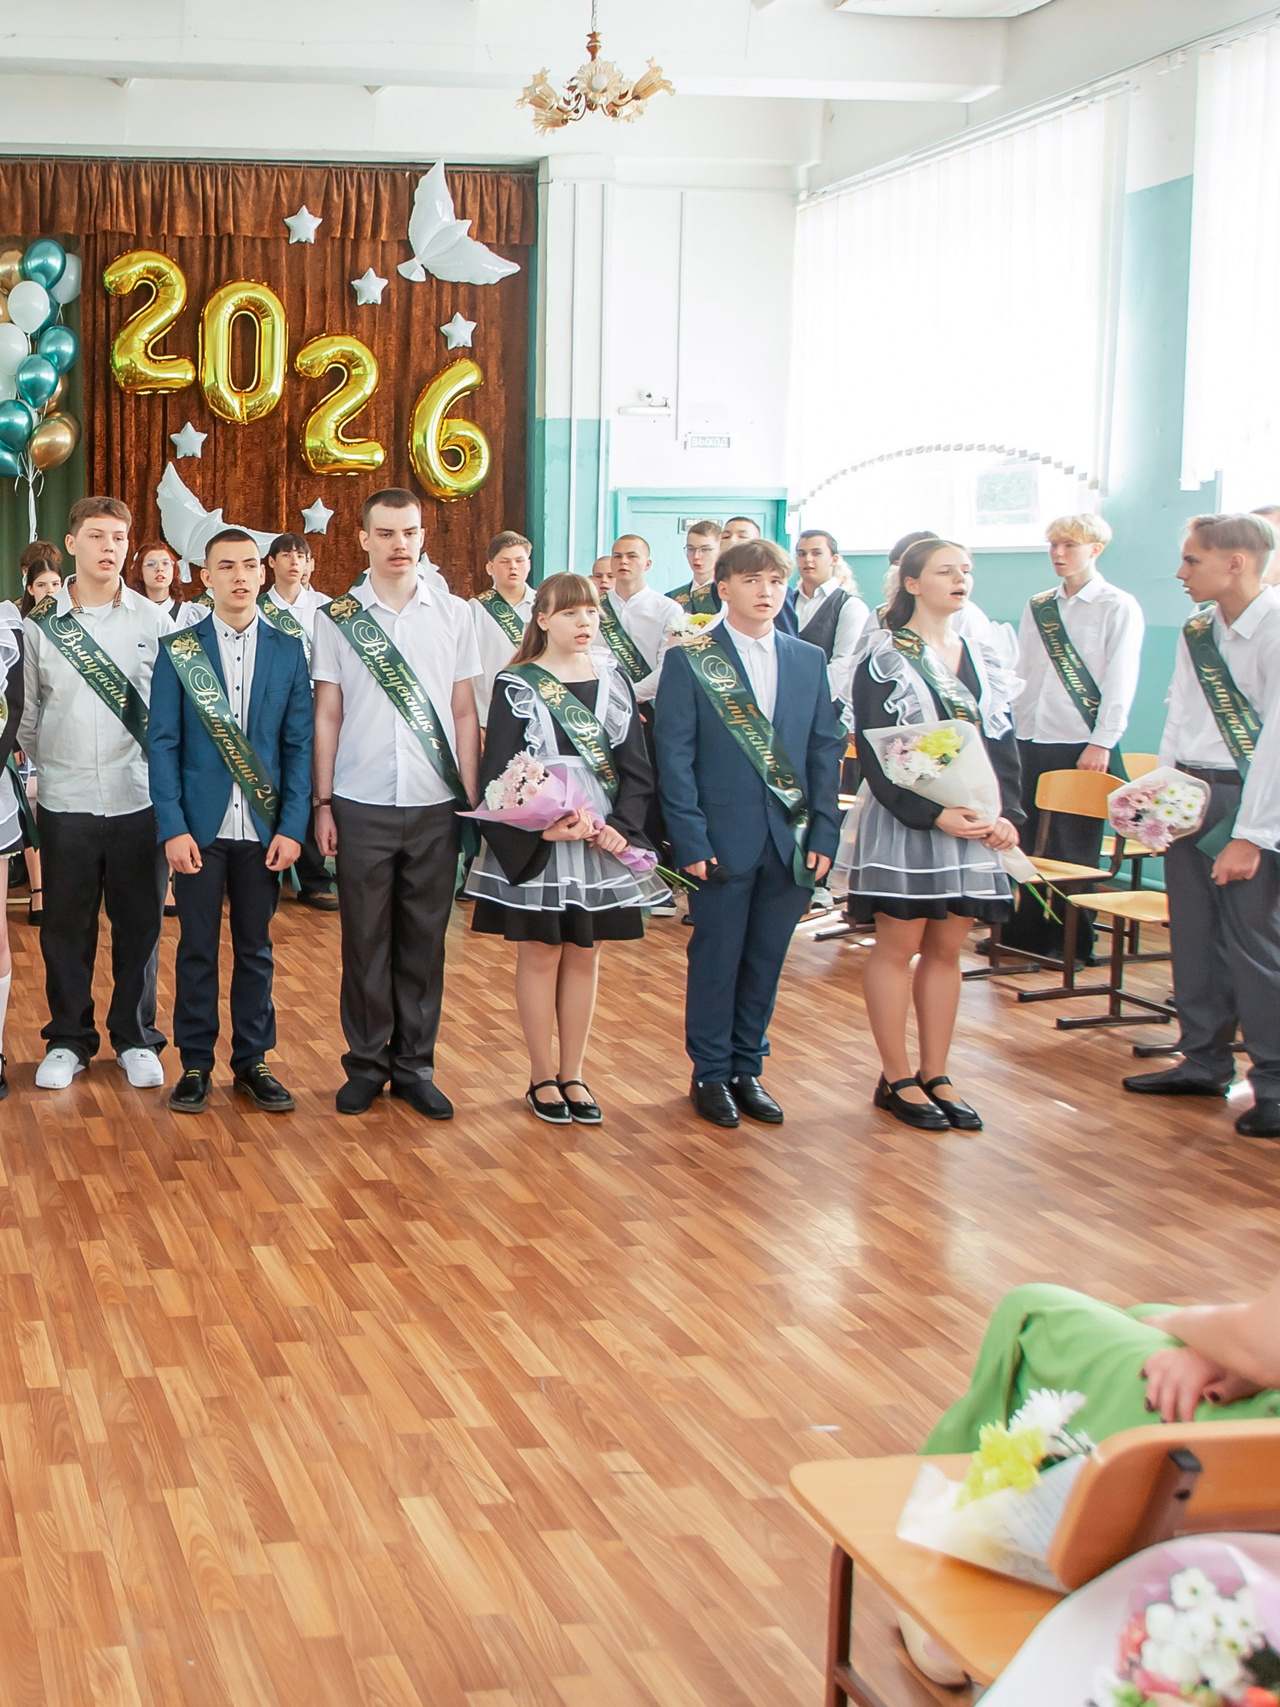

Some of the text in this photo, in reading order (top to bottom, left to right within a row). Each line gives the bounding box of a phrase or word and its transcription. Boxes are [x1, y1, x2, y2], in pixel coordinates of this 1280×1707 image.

[103, 248, 492, 503] 2026
[691, 437, 729, 448] ВЫХОД
[188, 665, 259, 786] Выпускник
[352, 619, 435, 732] Выпускник
[702, 654, 781, 773] Выпускник
